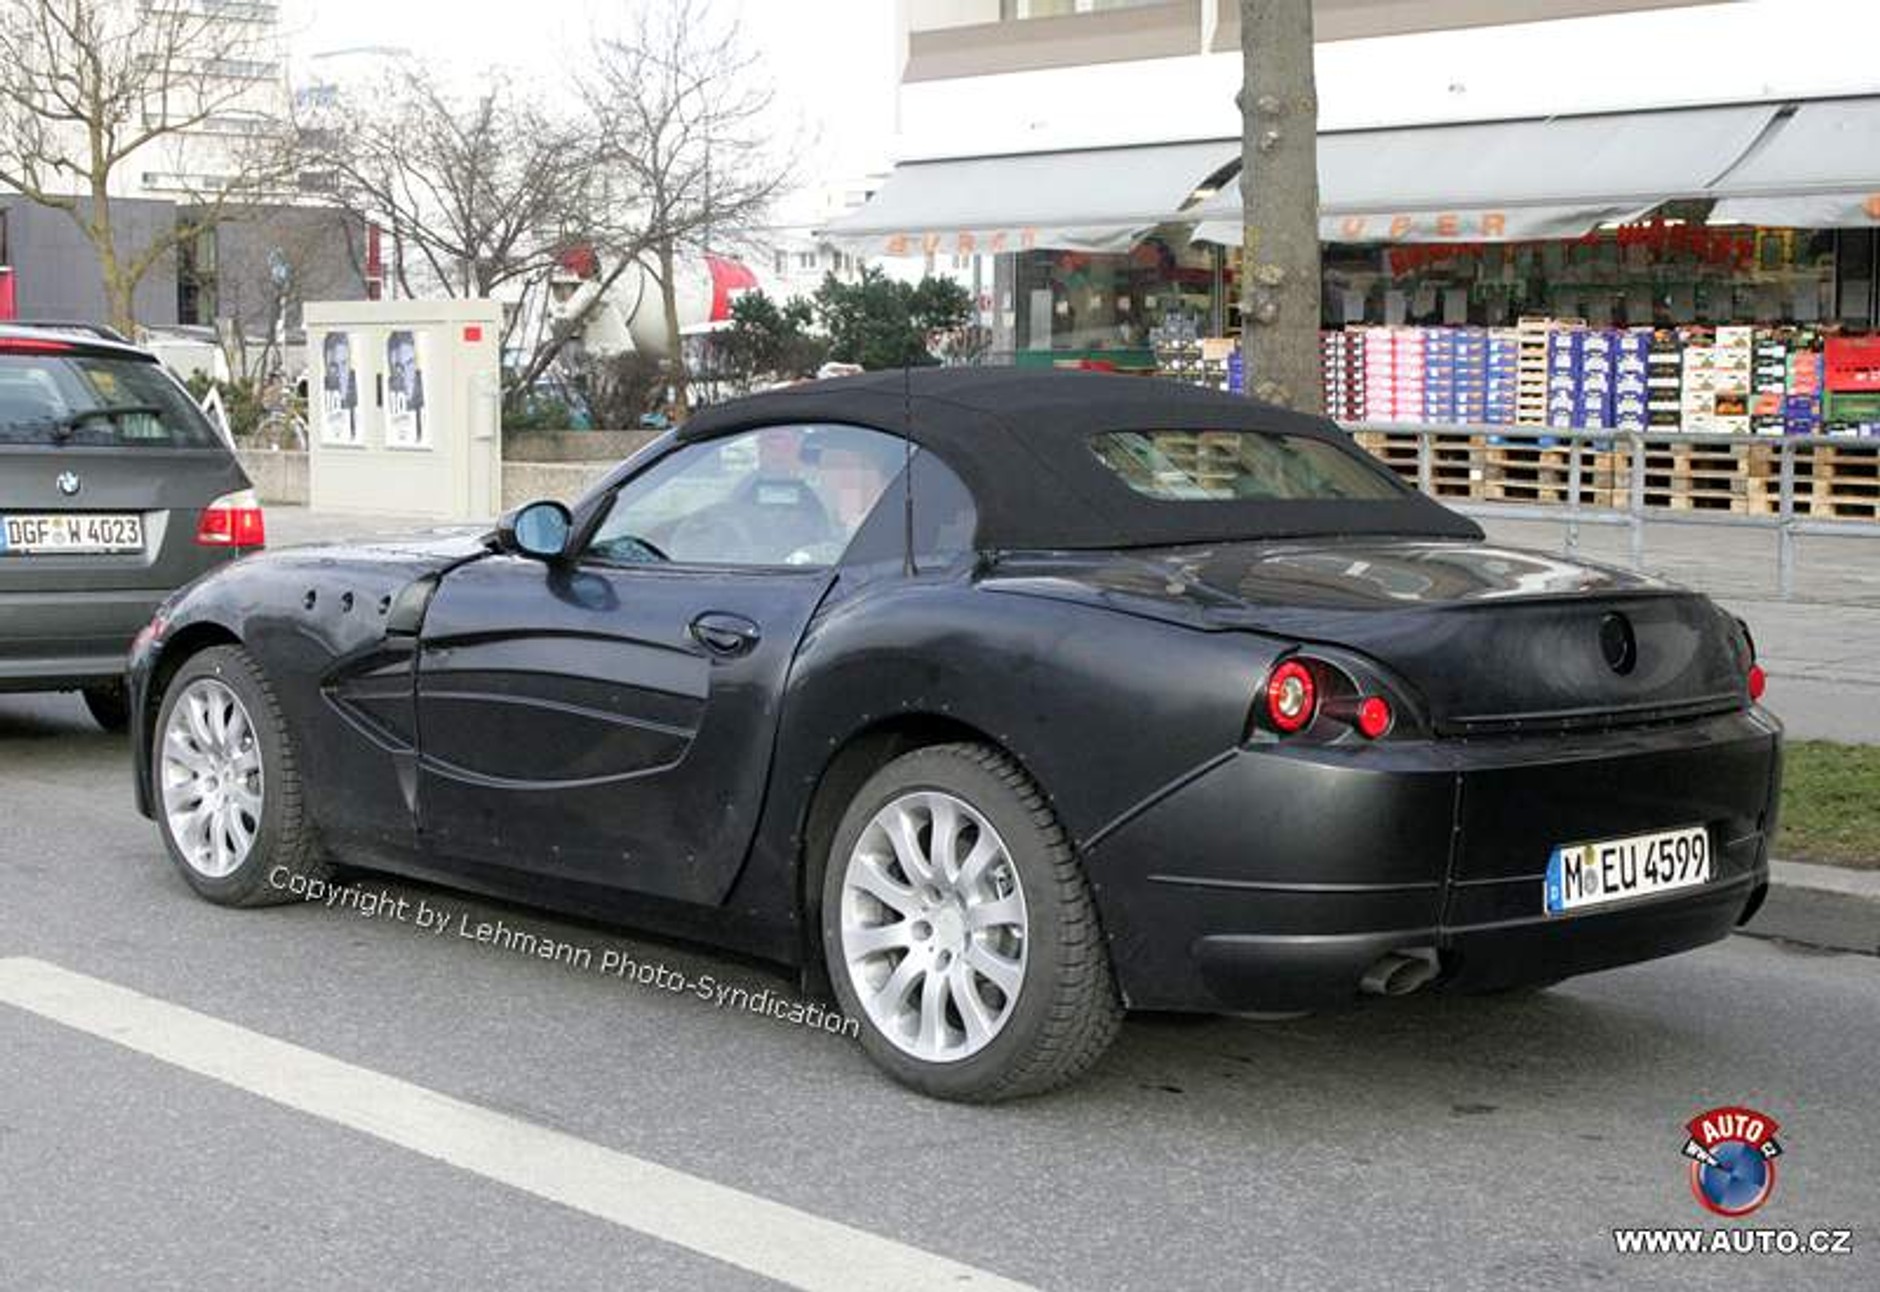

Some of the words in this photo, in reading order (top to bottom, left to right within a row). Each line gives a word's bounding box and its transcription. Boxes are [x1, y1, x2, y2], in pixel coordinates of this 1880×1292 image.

[8, 519, 48, 544] DGF
[67, 518, 81, 543] W
[88, 518, 138, 544] 4023
[1564, 853, 1583, 900] M
[1601, 845, 1637, 894] EU
[1645, 833, 1705, 885] 4599
